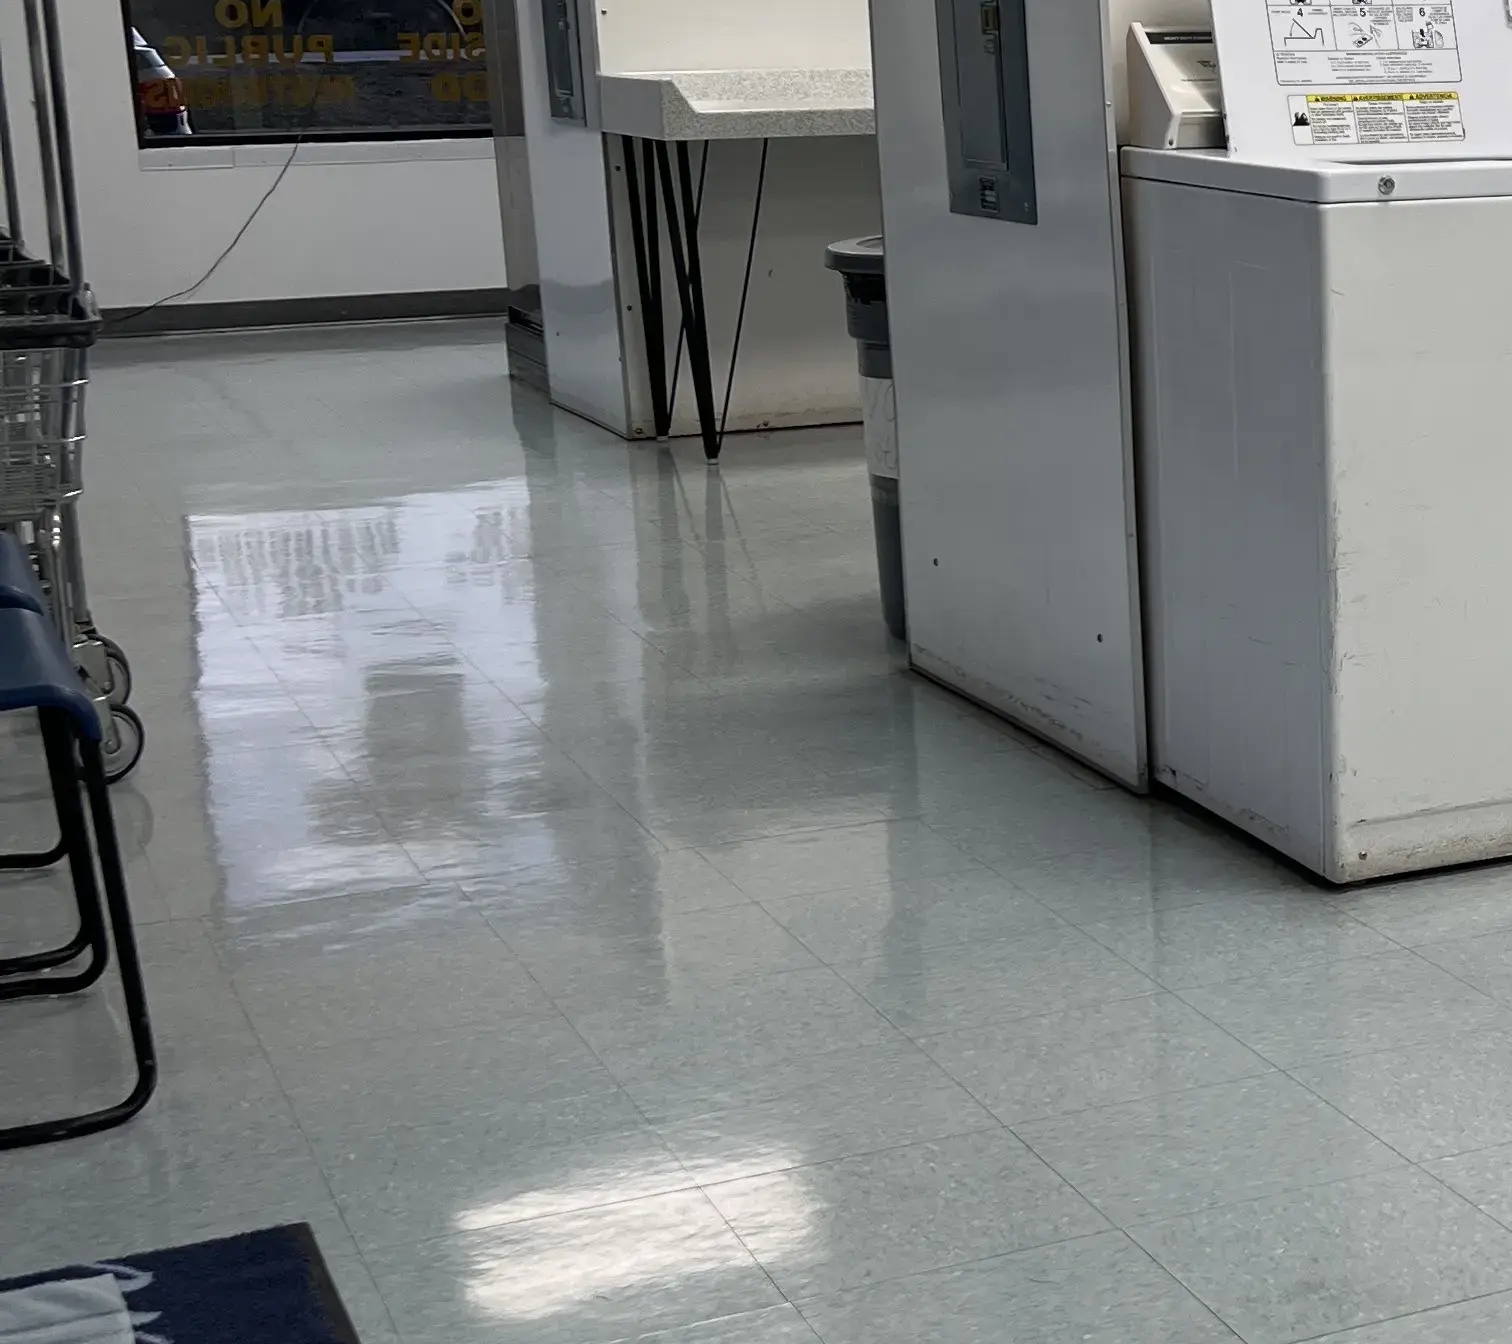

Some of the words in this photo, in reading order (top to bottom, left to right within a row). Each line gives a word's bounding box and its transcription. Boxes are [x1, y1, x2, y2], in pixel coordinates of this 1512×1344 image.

[1297, 8, 1304, 17] 4
[1359, 7, 1367, 17] 5
[1418, 7, 1426, 17] 6
